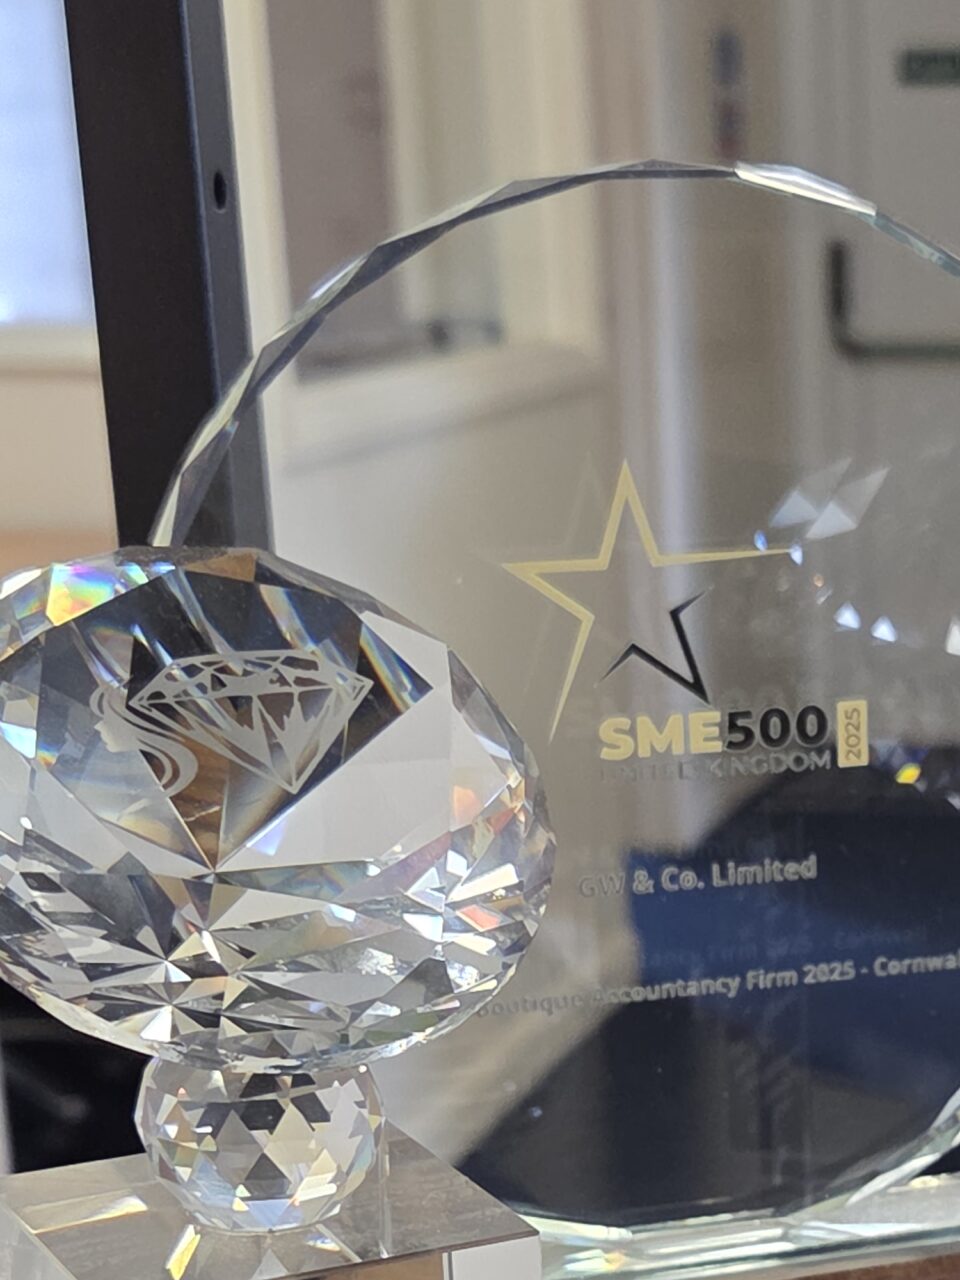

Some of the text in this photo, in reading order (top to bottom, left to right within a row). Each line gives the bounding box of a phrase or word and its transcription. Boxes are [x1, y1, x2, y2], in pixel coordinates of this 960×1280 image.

[599, 705, 829, 761] SME500
[845, 707, 862, 761] 2025
[710, 750, 832, 778] KNGDOM
[632, 869, 655, 895] &
[661, 867, 705, 892] Co.
[712, 854, 817, 888] Limited
[592, 974, 741, 1004] Accountancy
[746, 968, 798, 991] Firm
[803, 960, 857, 984] 2025
